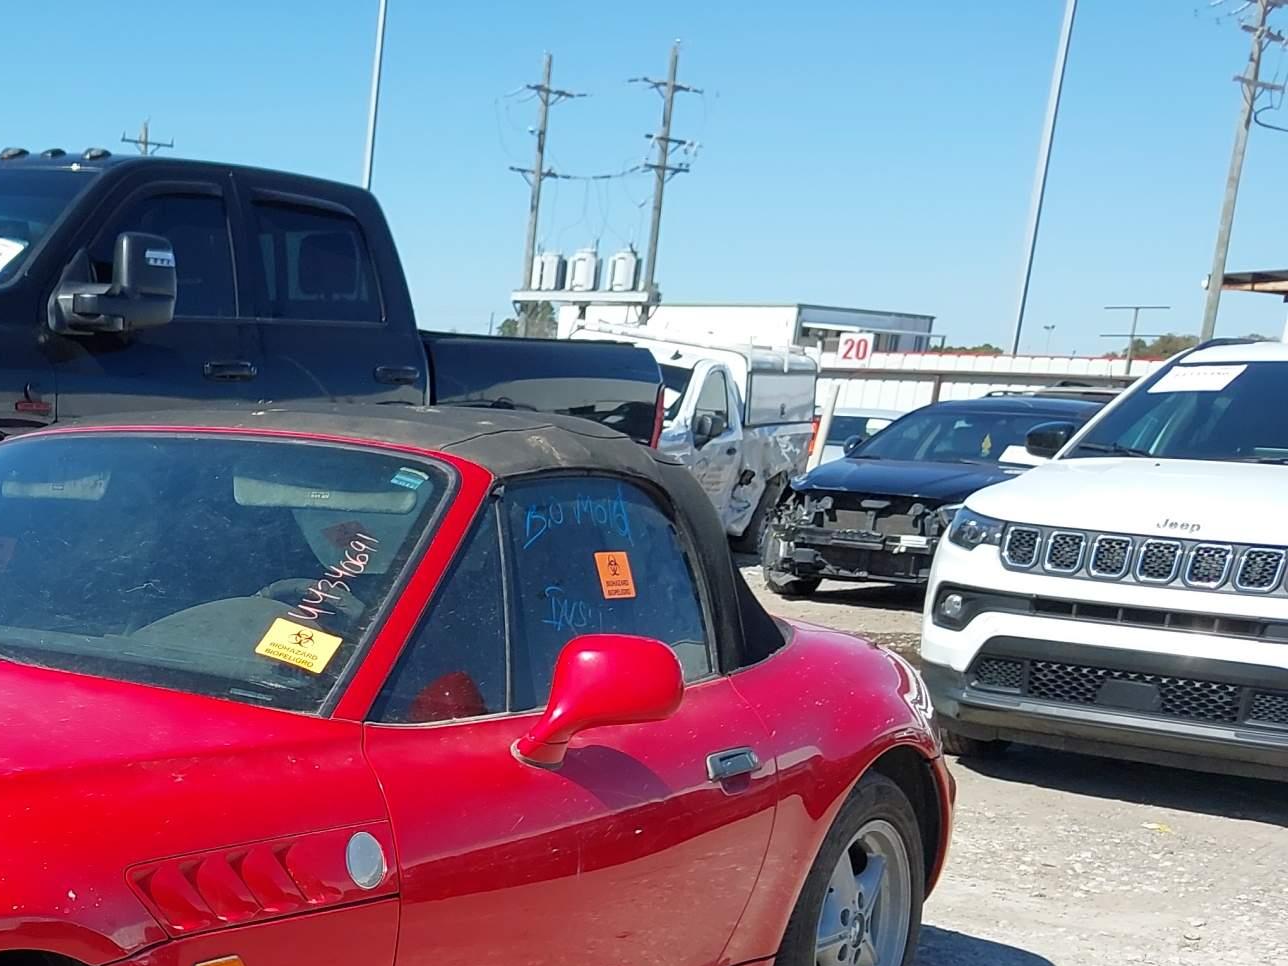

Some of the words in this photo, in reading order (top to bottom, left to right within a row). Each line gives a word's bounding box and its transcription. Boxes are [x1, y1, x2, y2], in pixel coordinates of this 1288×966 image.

[843, 338, 868, 360] 20
[1156, 518, 1201, 534] Jeep
[288, 532, 380, 620] 44340691
[265, 648, 315, 668] BIOPELIGRO
[270, 642, 318, 661] BIOHAZARD
